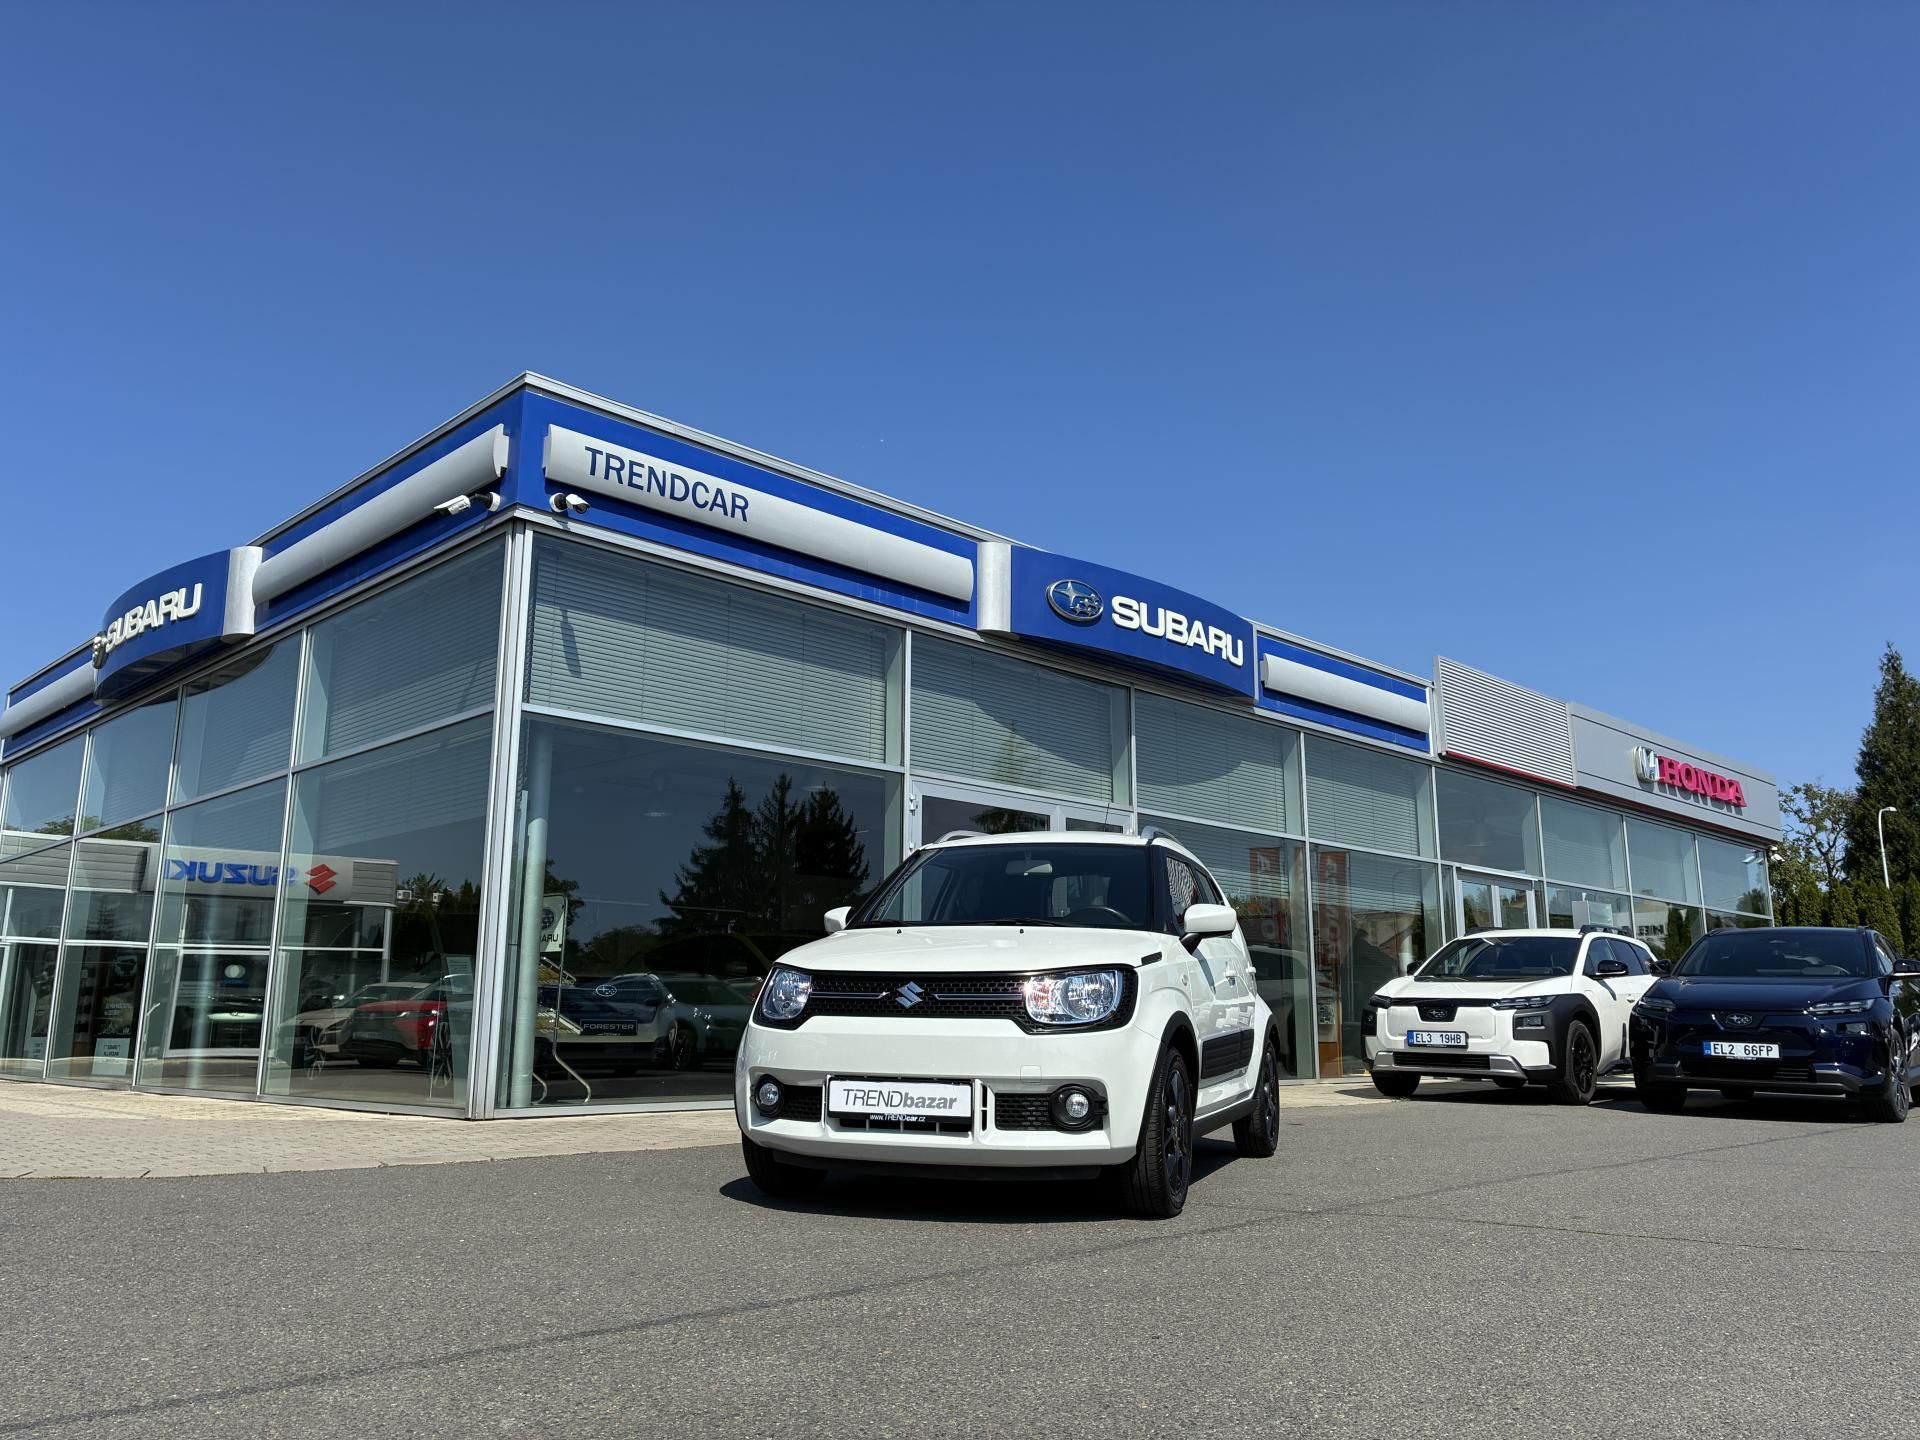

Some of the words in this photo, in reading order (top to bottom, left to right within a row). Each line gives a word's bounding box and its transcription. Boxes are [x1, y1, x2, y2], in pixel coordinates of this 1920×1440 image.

[585, 446, 749, 523] TRENDCAR
[105, 583, 202, 653] SUBARU
[1112, 595, 1244, 667] SUBARU
[1656, 754, 1747, 807] HONDA
[1415, 1033, 1432, 1043] EL3
[1440, 1034, 1462, 1044] 19HB
[1713, 1043, 1735, 1055] EL2
[1744, 1044, 1773, 1056] 66FP
[843, 1088, 957, 1110] TRENDbazar
[869, 1113, 926, 1122] www.TRENDcar.cz
